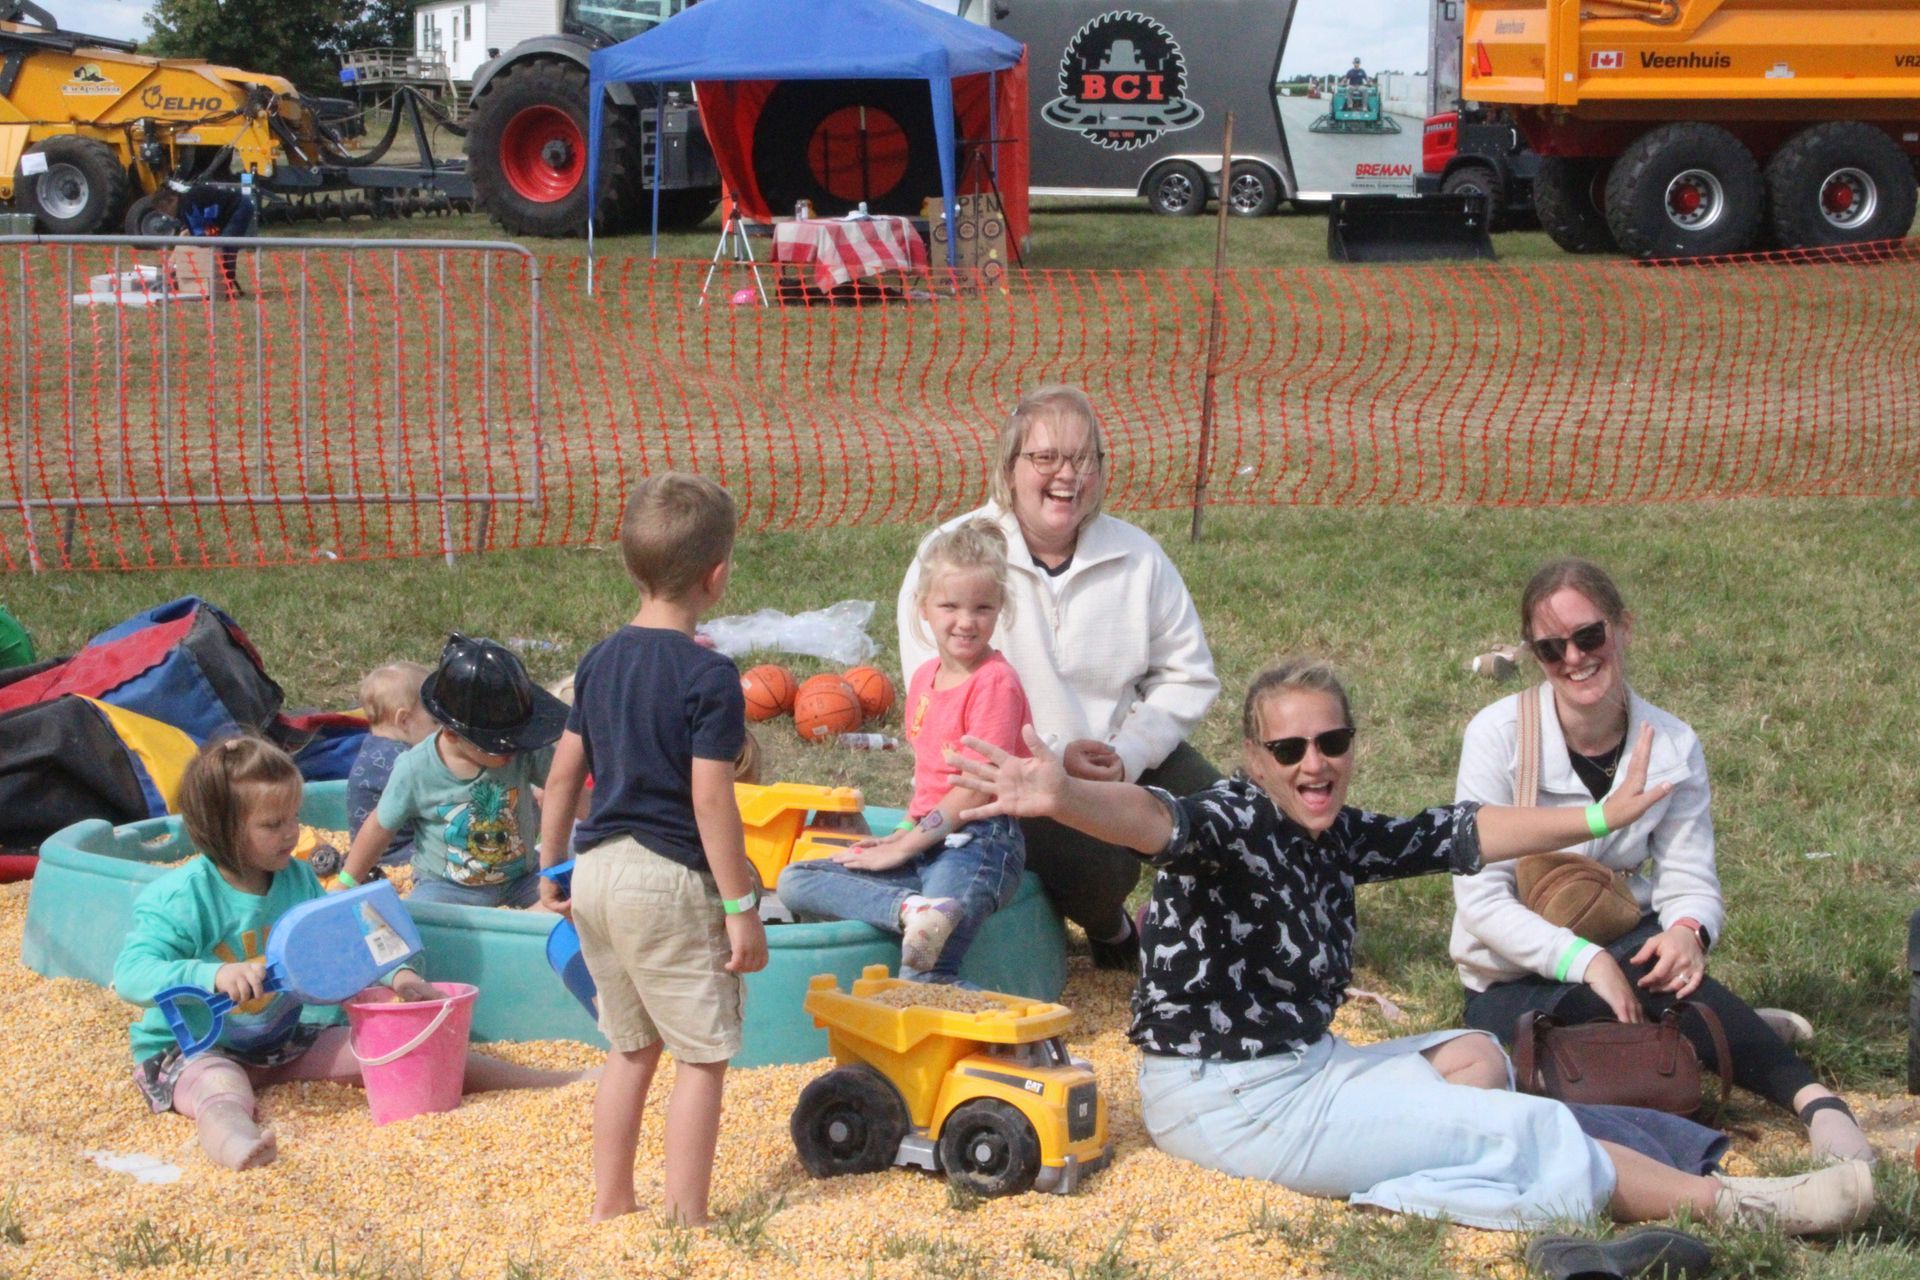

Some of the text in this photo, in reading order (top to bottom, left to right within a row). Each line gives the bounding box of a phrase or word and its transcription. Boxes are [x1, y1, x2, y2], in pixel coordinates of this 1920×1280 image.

[1640, 51, 1731, 68] Veenhuis
[1081, 74, 1164, 100] BCI
[163, 97, 222, 112] ELHO
[1355, 163, 1412, 176] BREMAN
[957, 194, 1000, 215] PEN
[1024, 1079, 1043, 1093] CAT
